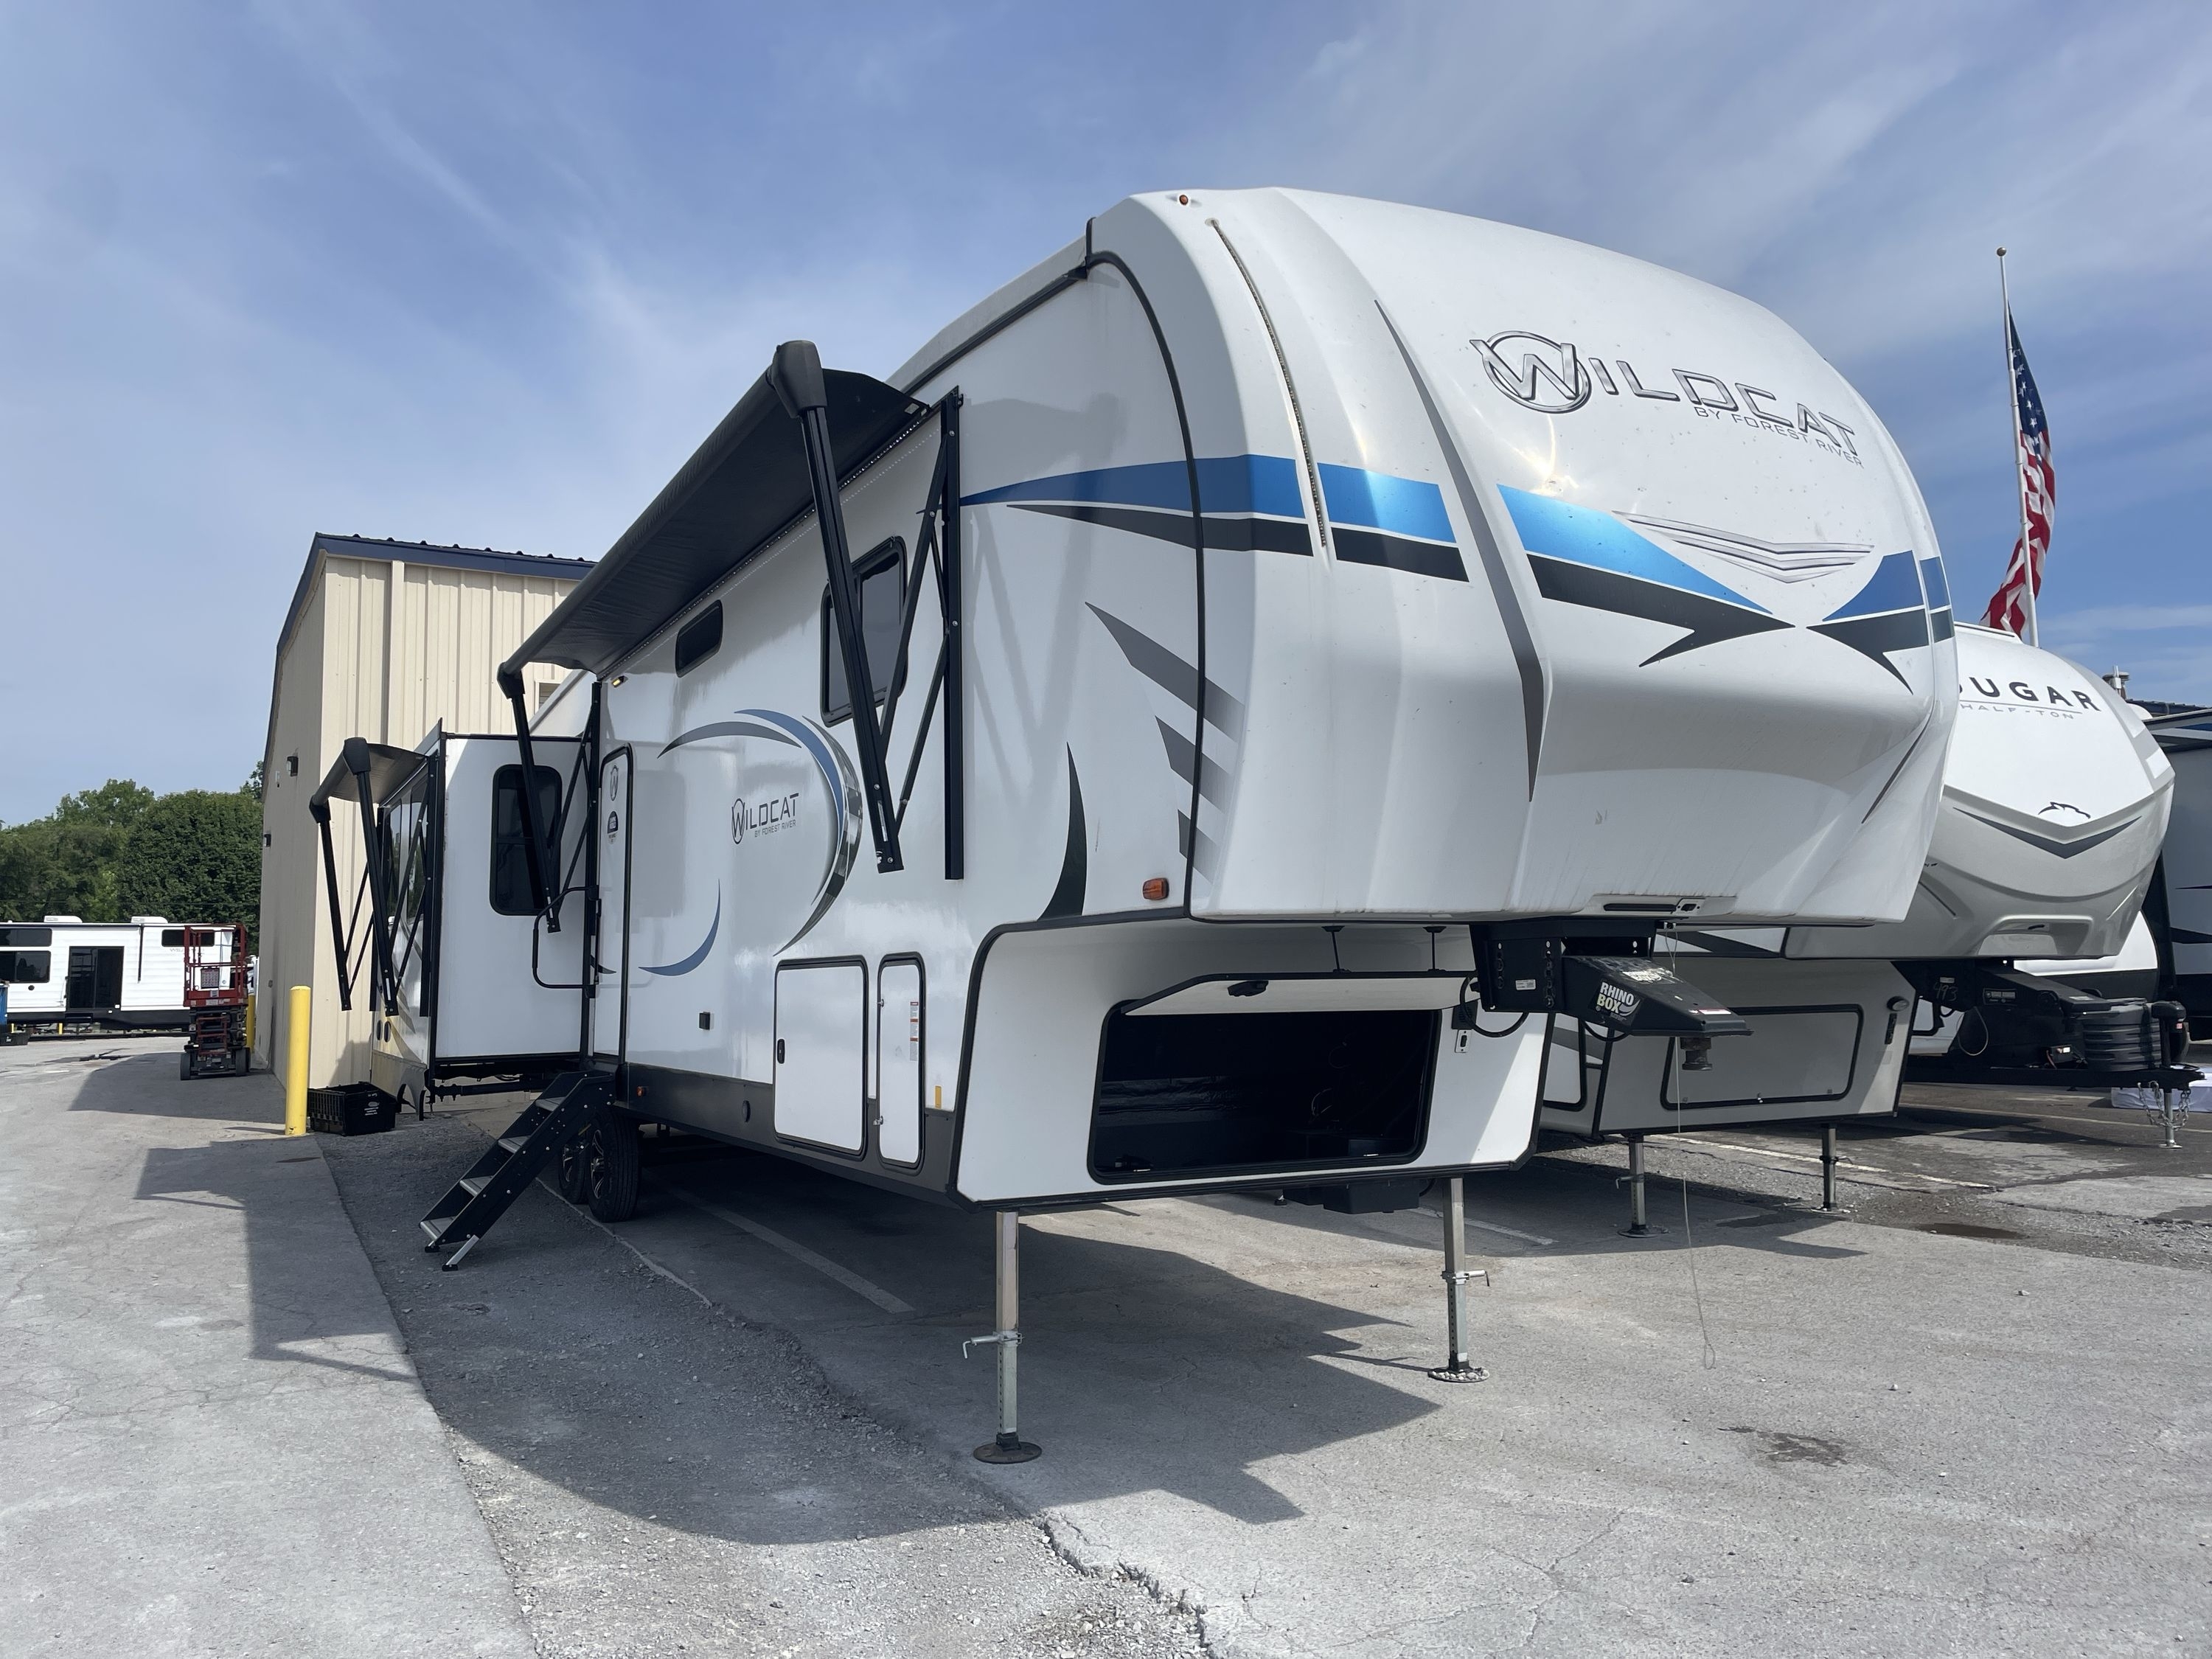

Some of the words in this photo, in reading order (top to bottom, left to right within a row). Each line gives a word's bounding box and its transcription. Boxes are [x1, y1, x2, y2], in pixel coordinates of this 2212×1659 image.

[1470, 330, 1857, 456] WILDCAT
[1694, 406, 1720, 419] BY
[1731, 414, 1809, 442] FOREST
[1815, 439, 1864, 469] RIVER
[1959, 677, 2101, 712] UGAR
[731, 793, 799, 844] WILDCAT
[754, 830, 761, 838] BY
[762, 824, 780, 835] FOREST
[782, 819, 796, 830] RIVER
[1597, 993, 1621, 1014] BOX
[1599, 981, 1634, 1006] RHINO
